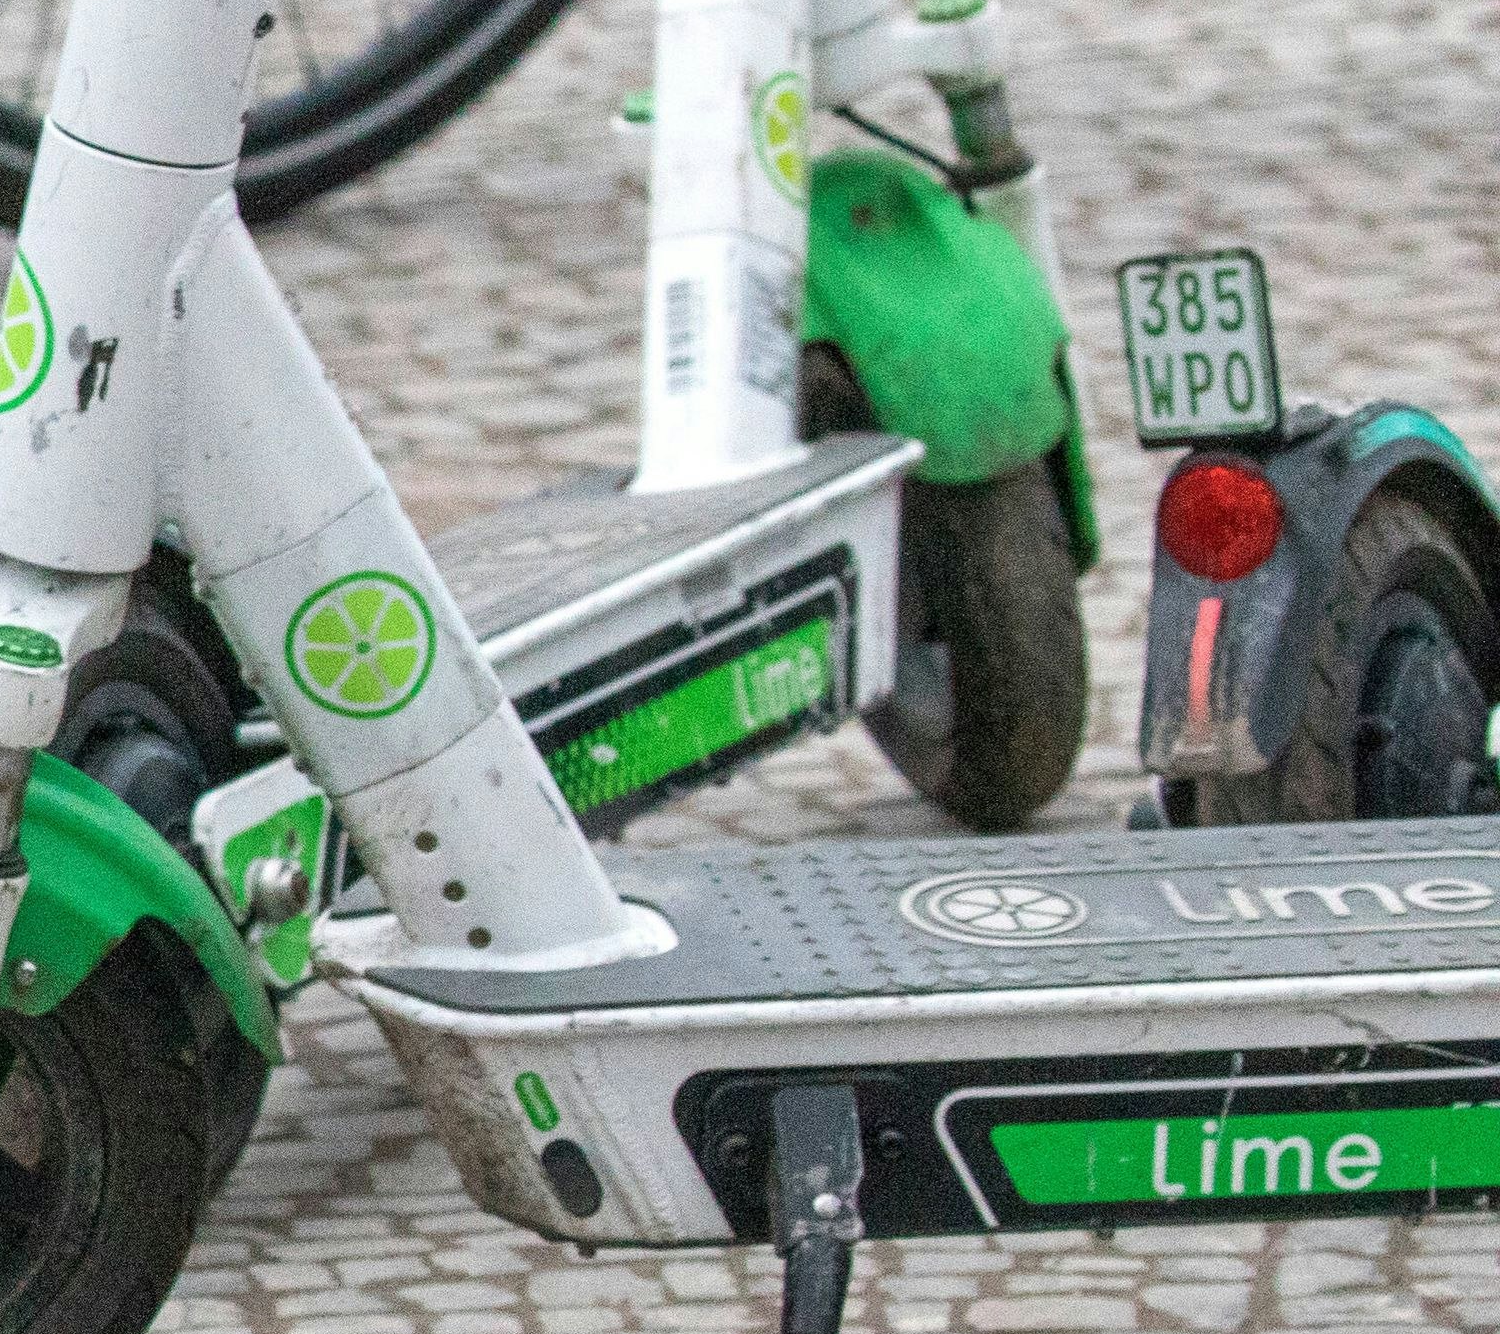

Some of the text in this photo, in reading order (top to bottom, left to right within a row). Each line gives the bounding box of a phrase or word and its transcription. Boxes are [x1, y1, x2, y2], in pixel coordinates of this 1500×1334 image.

[1139, 267, 1246, 337] 385
[1159, 876, 1497, 925] Lime
[1151, 1120, 1382, 1198] Lime
